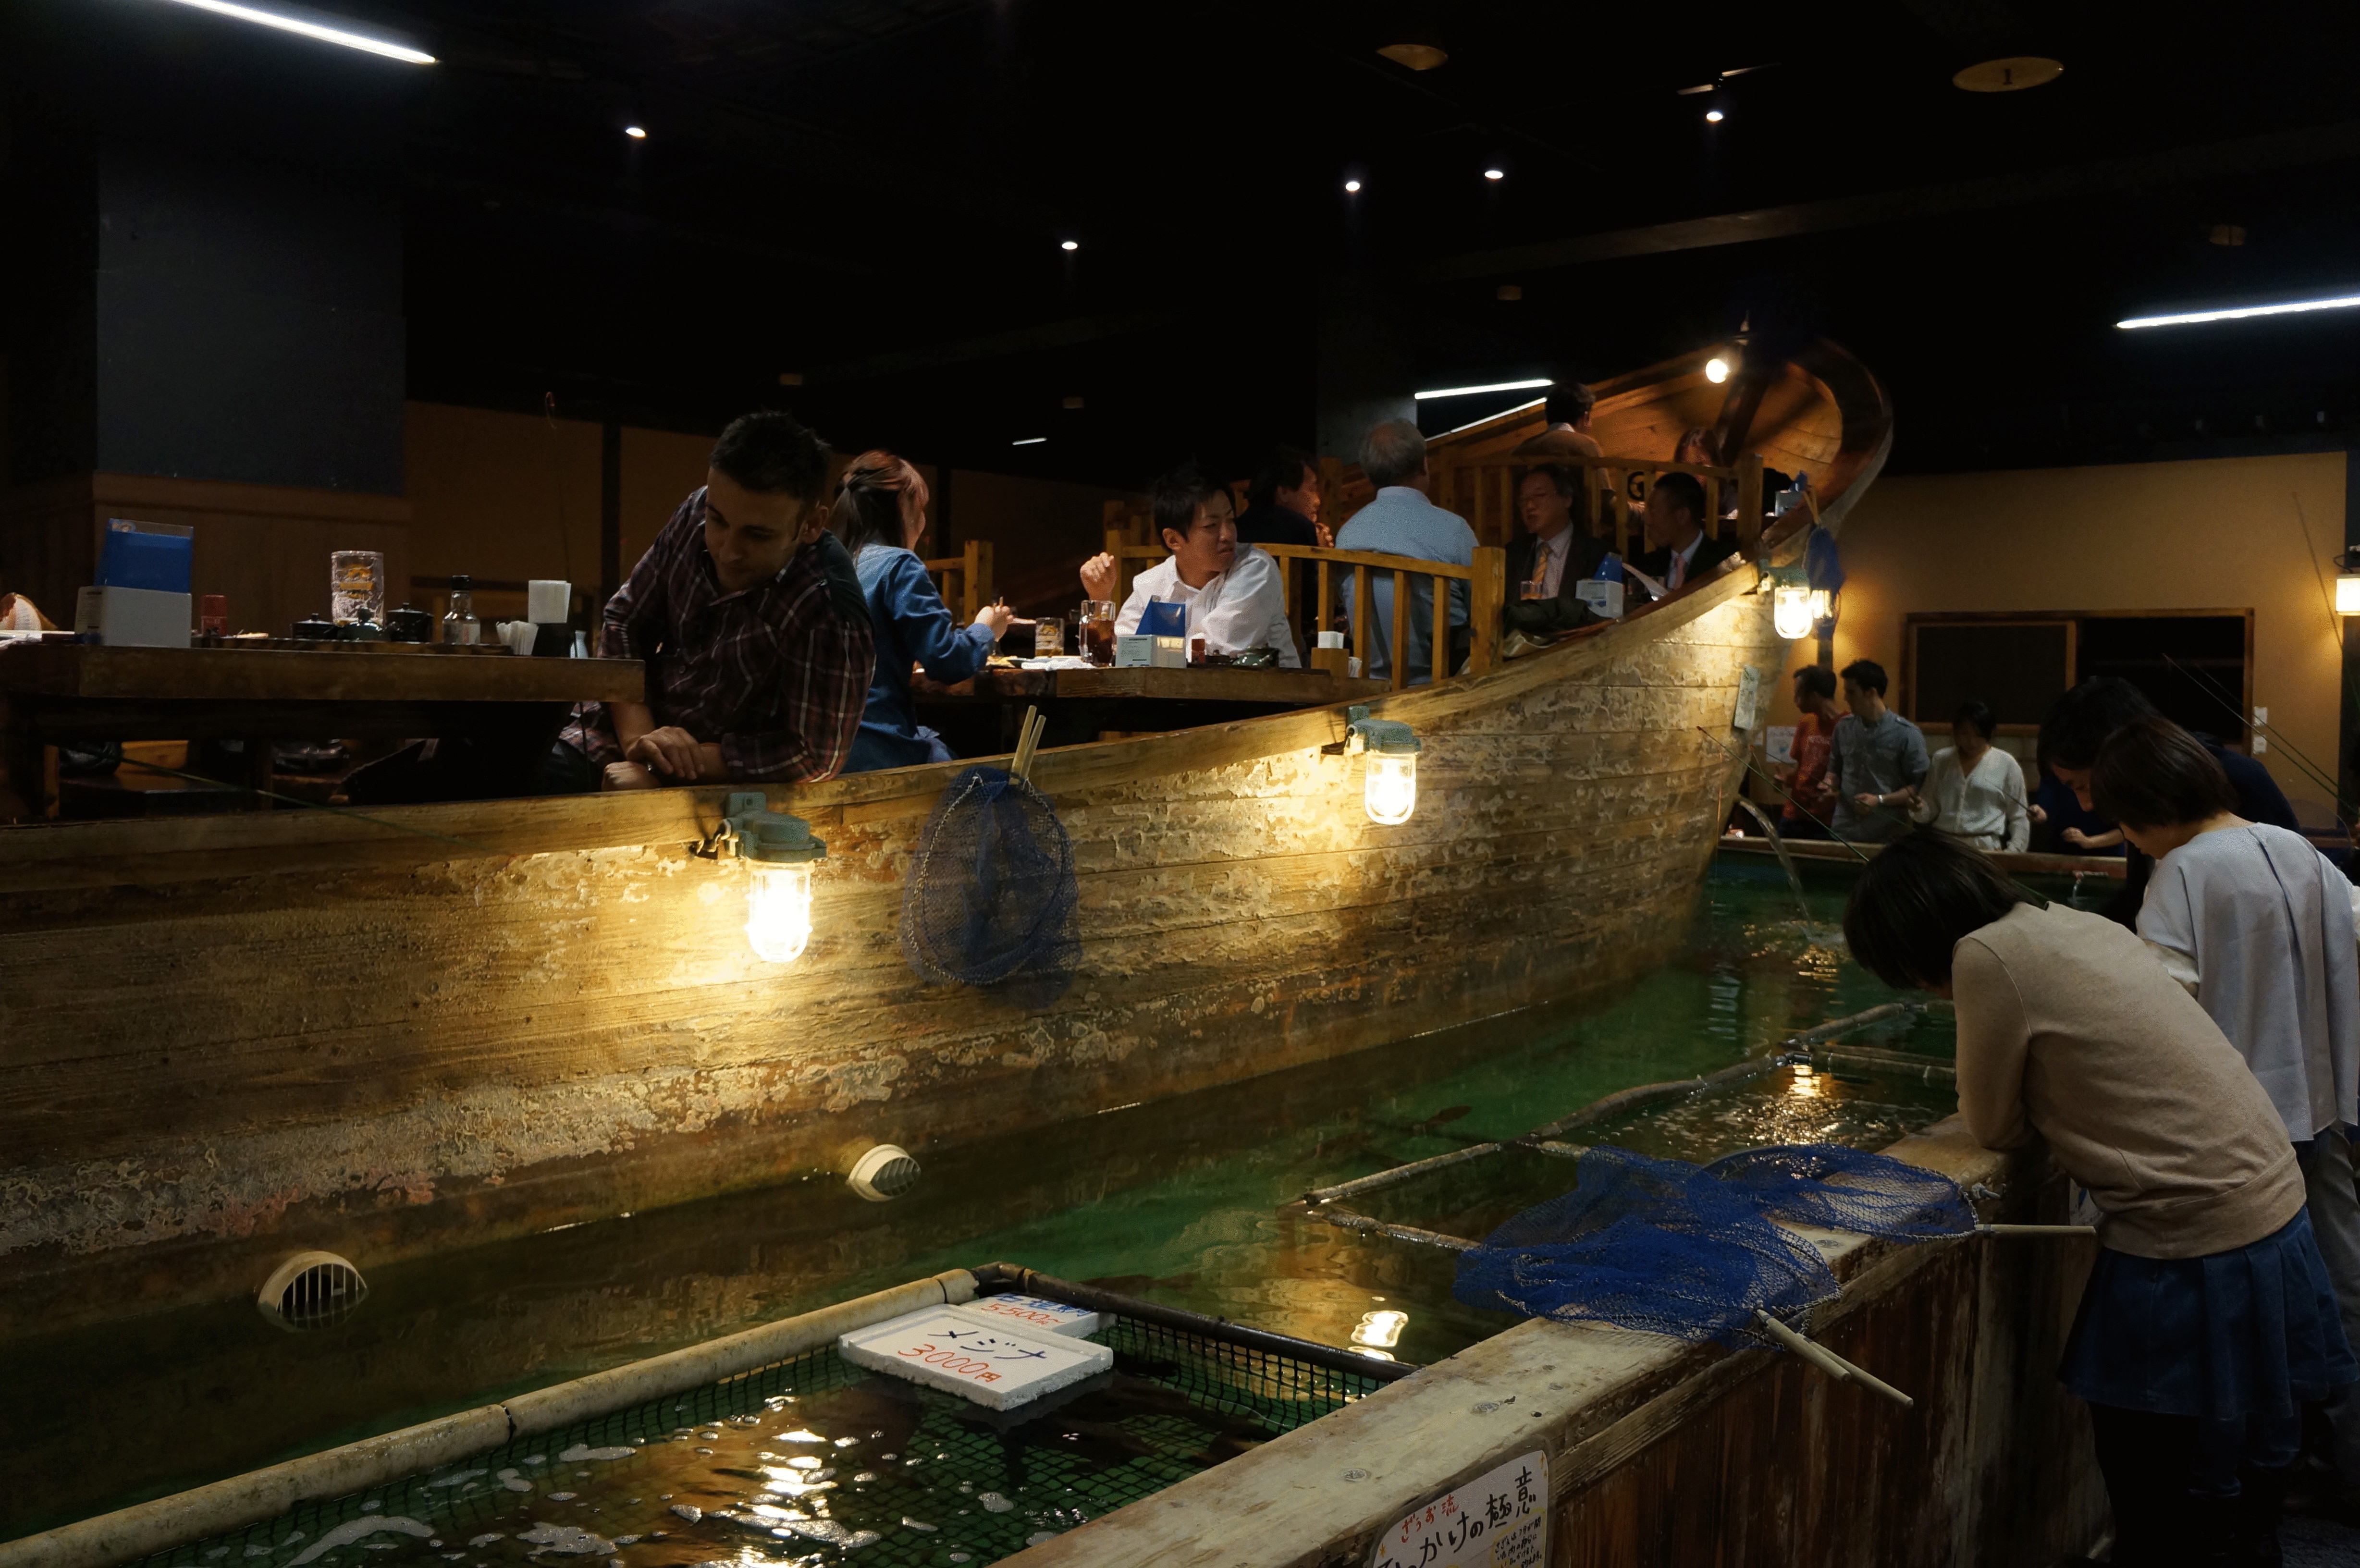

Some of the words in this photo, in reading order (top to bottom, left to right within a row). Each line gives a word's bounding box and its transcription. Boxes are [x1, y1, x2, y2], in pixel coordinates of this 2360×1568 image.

[897, 1344, 1002, 1383] 3000円
[928, 1331, 1047, 1359] メジナ
[1401, 1494, 1459, 1543] ざうお流
